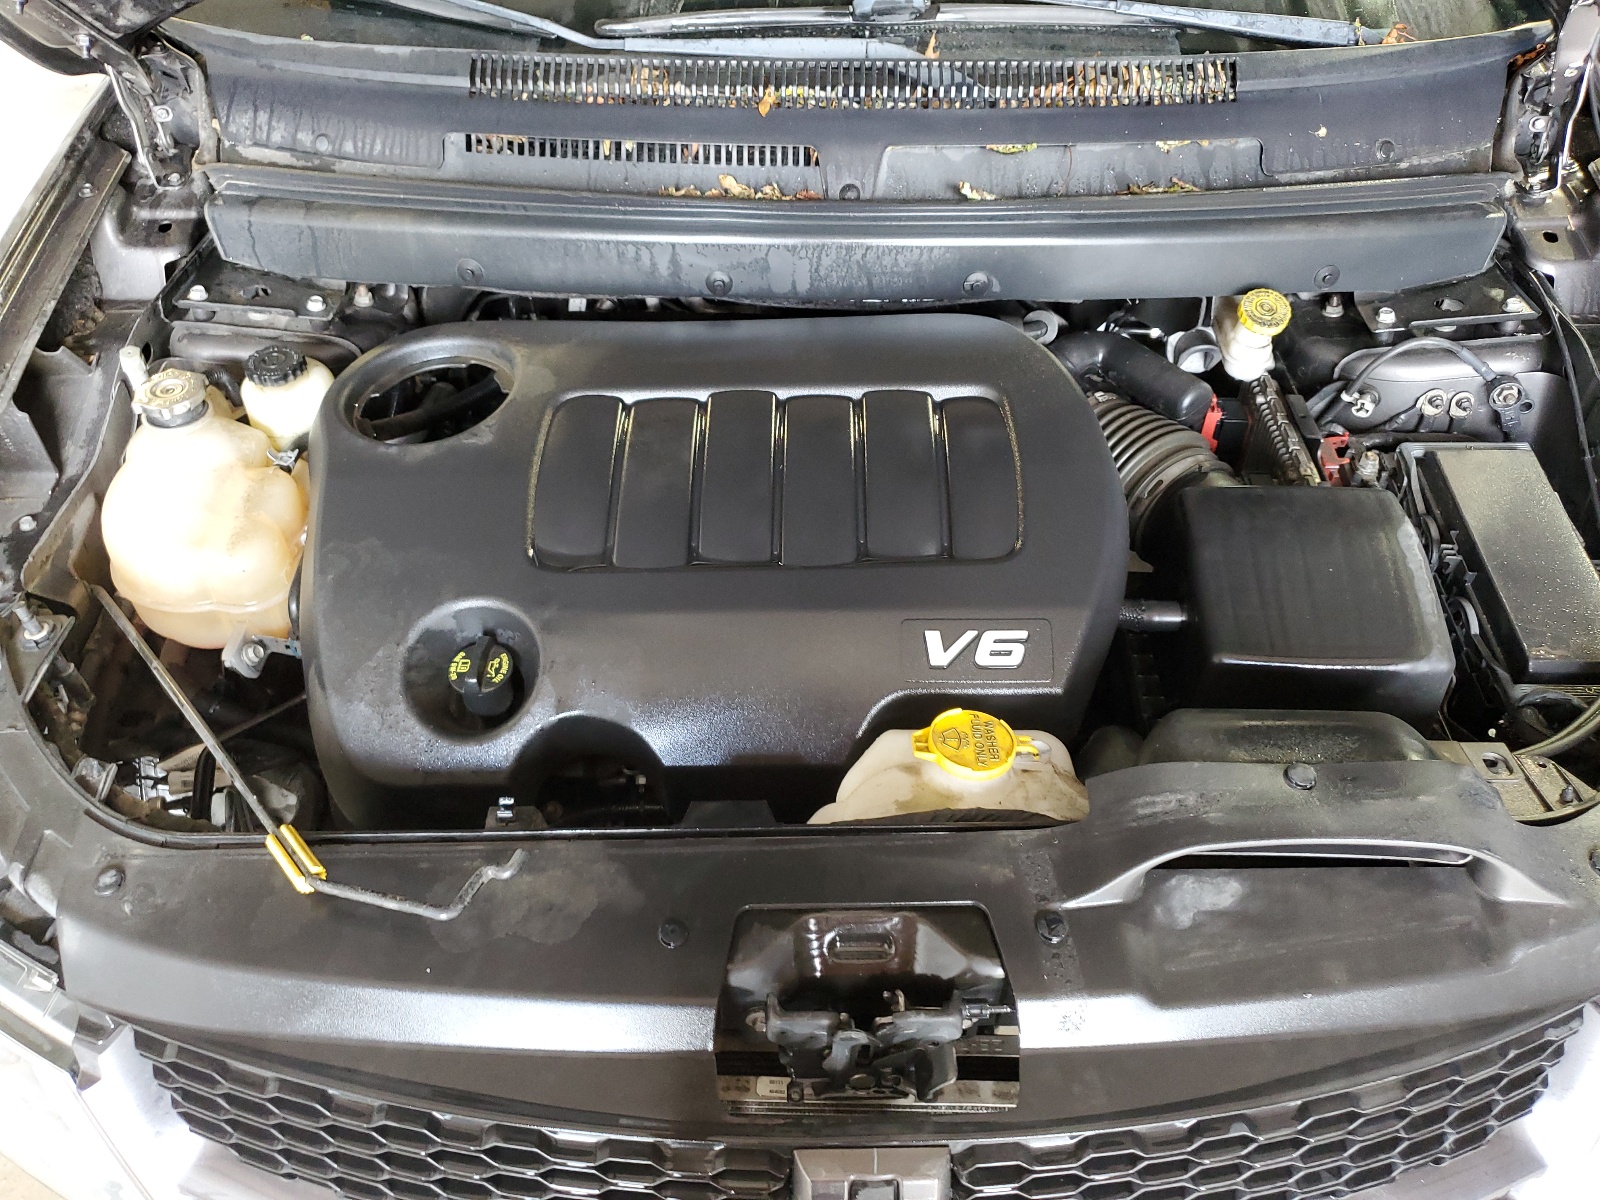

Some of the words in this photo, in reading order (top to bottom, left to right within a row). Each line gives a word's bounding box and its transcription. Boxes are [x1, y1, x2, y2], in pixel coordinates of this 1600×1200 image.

[923, 629, 1030, 669] V6
[500, 652, 509, 675] ENGINE
[491, 673, 504, 684] OIL
[969, 713, 983, 741] FLUID
[983, 720, 1000, 762] WASHER
[974, 742, 989, 768] ONLY
